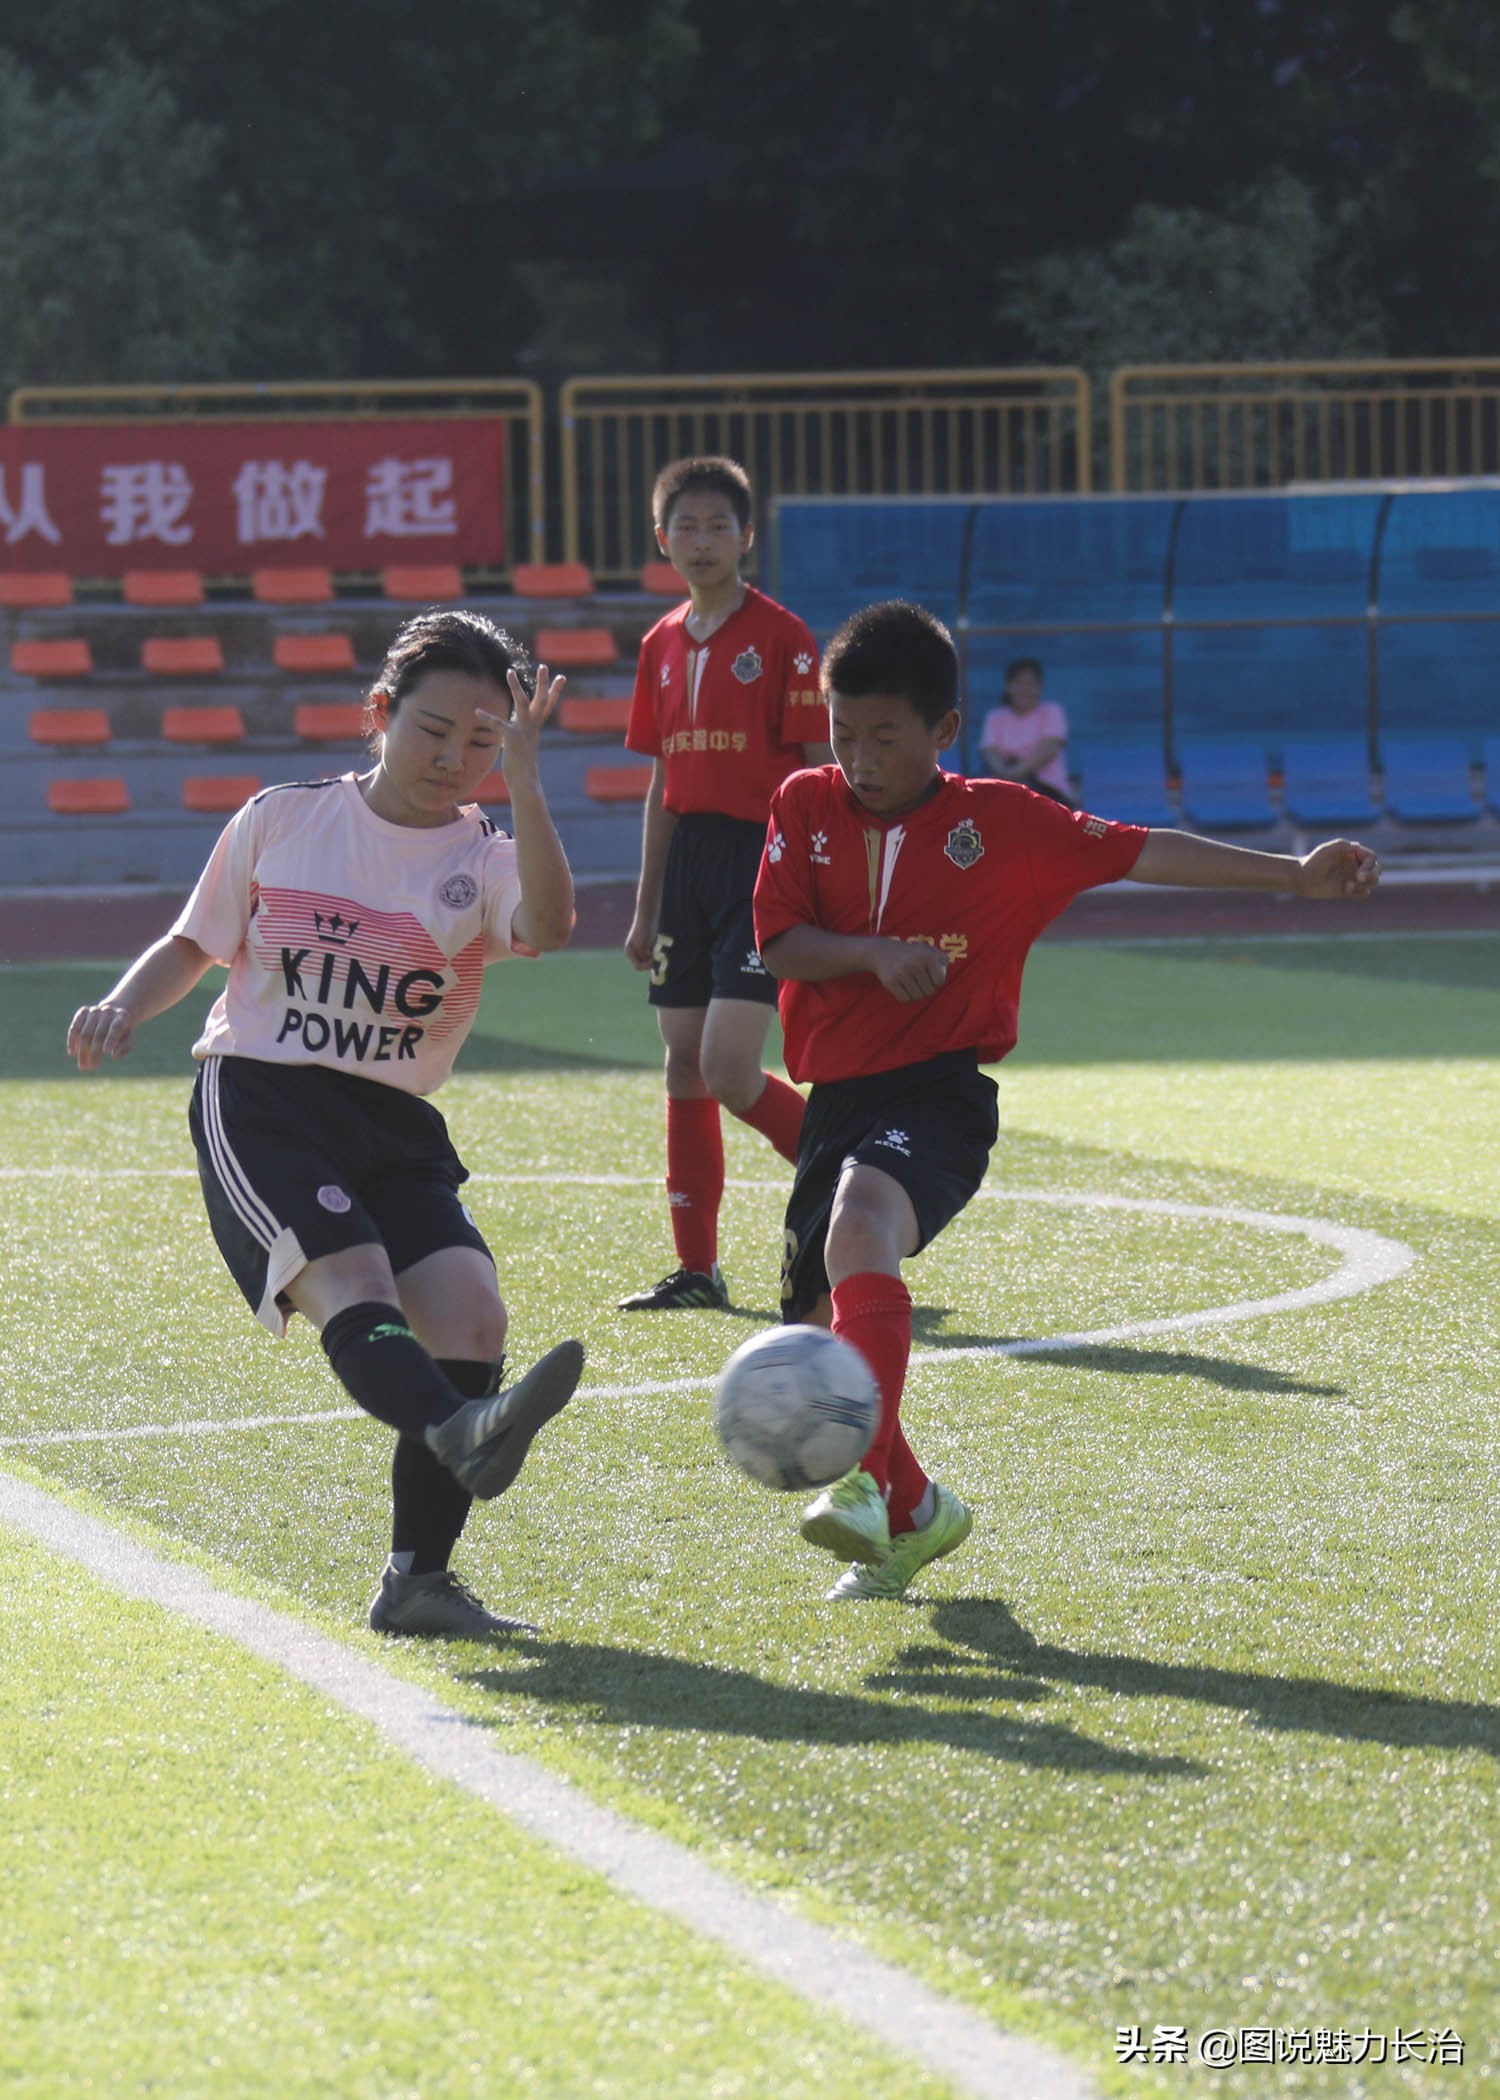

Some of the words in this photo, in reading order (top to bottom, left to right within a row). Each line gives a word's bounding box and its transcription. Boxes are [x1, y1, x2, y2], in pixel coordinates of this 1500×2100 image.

[281, 946, 446, 1018] KING
[651, 933, 674, 986] 5
[275, 1007, 424, 1062] POWER
